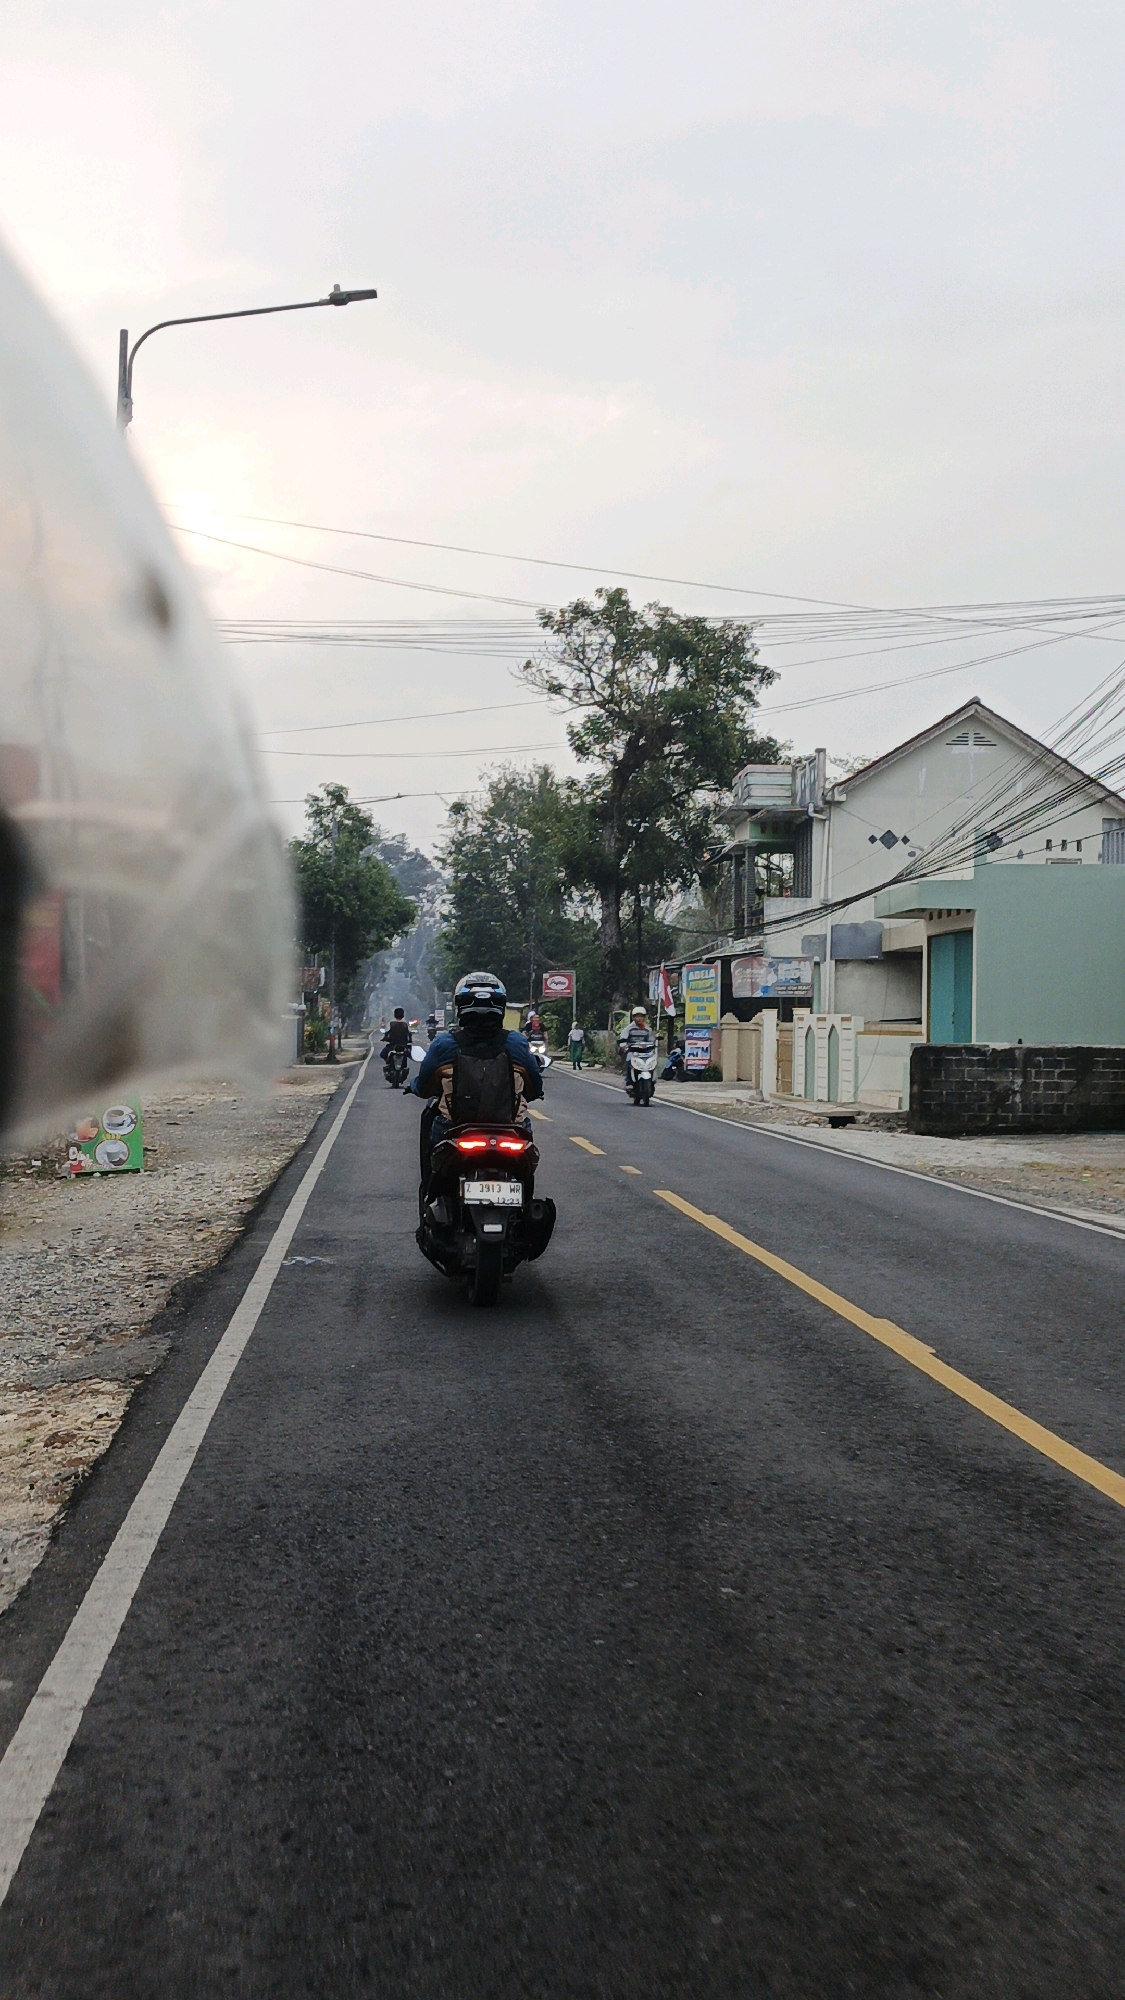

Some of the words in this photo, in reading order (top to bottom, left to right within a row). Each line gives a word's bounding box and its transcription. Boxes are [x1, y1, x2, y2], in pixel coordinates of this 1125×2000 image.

[688, 968, 716, 980] ADELA
[687, 1047, 709, 1058] ATM
[466, 1183, 471, 1193] Z
[479, 1183, 502, 1193] 3913
[509, 1184, 521, 1194] WR
